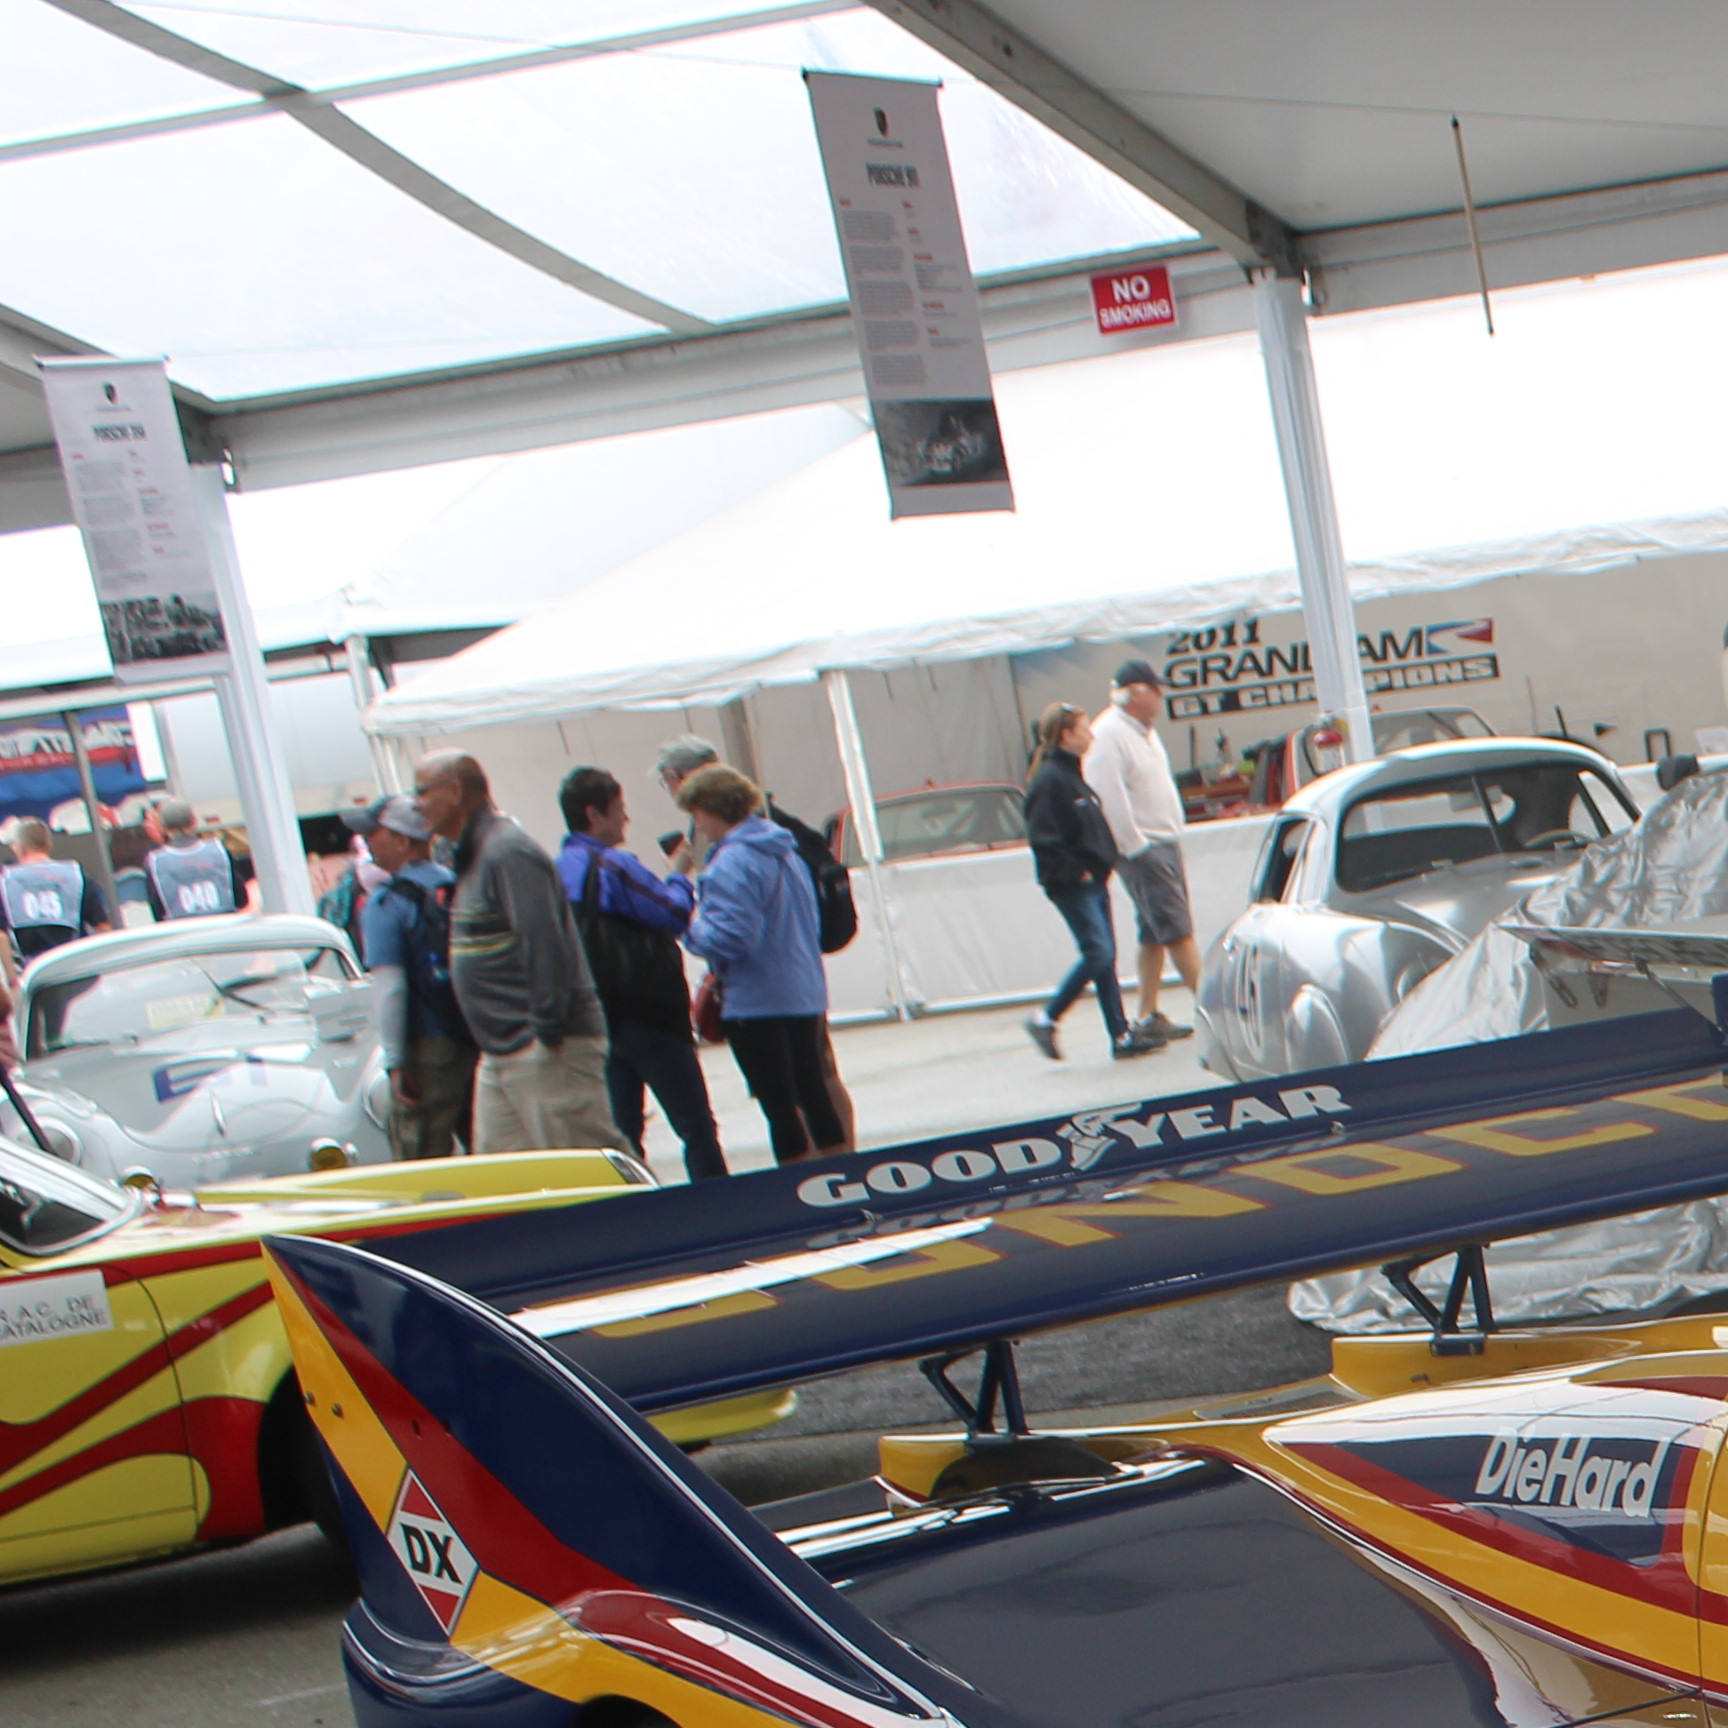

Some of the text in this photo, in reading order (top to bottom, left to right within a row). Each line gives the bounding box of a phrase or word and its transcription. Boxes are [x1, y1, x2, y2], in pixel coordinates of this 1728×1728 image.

[1111, 275, 1151, 303] NO
[1099, 298, 1171, 328] SMOKING
[1167, 617, 1262, 655] 2011
[1237, 655, 1496, 710] CHAPIONS
[0, 1309, 109, 1339] ATALOGNE
[1475, 1424, 1672, 1519] DieHard
[400, 1522, 463, 1585] DX
